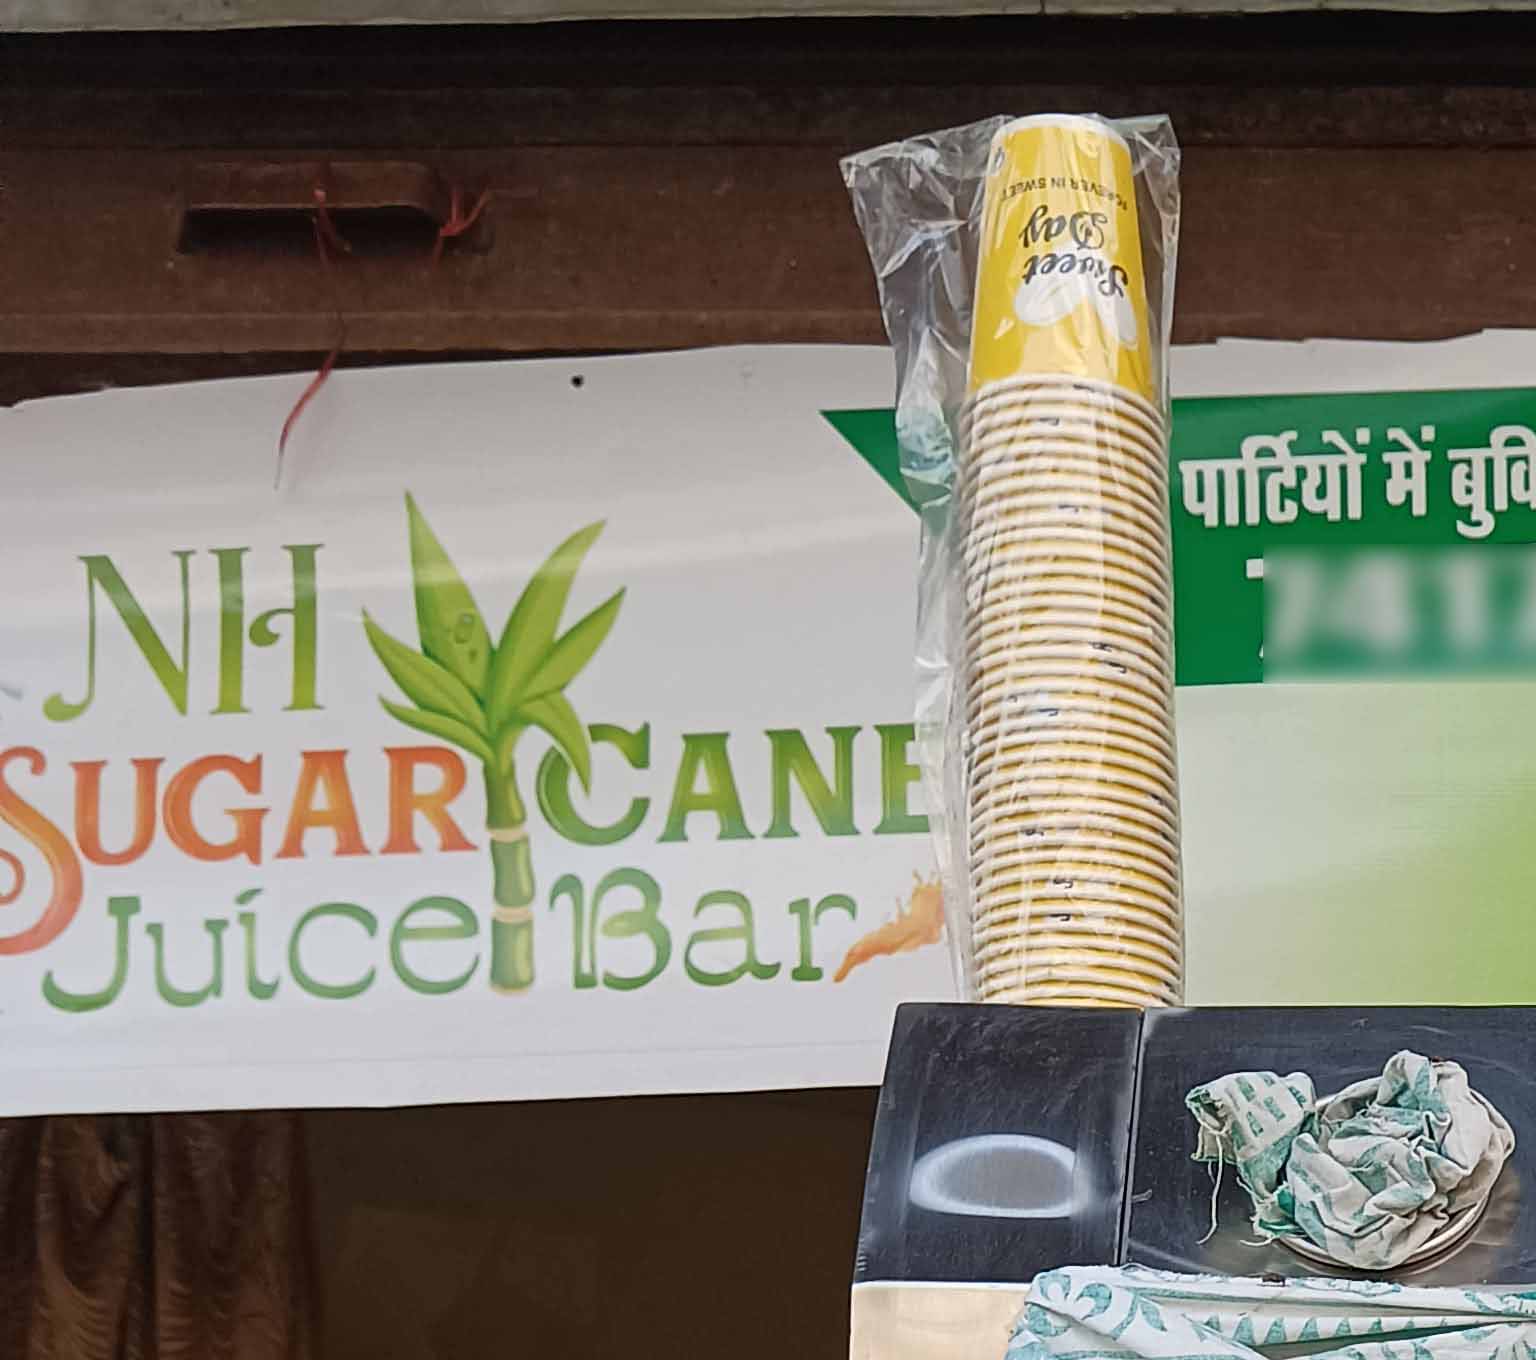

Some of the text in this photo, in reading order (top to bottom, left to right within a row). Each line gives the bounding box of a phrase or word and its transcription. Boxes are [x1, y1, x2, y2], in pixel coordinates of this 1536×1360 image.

[1019, 204, 1108, 250] Day
[1021, 254, 1129, 298] Sweet
[1178, 427, 1372, 528] पार्टियों
[1382, 425, 1436, 517] में
[42, 544, 326, 723] NH
[0, 721, 931, 957] SUGAR CANE
[41, 867, 859, 1014] Juice Bar
